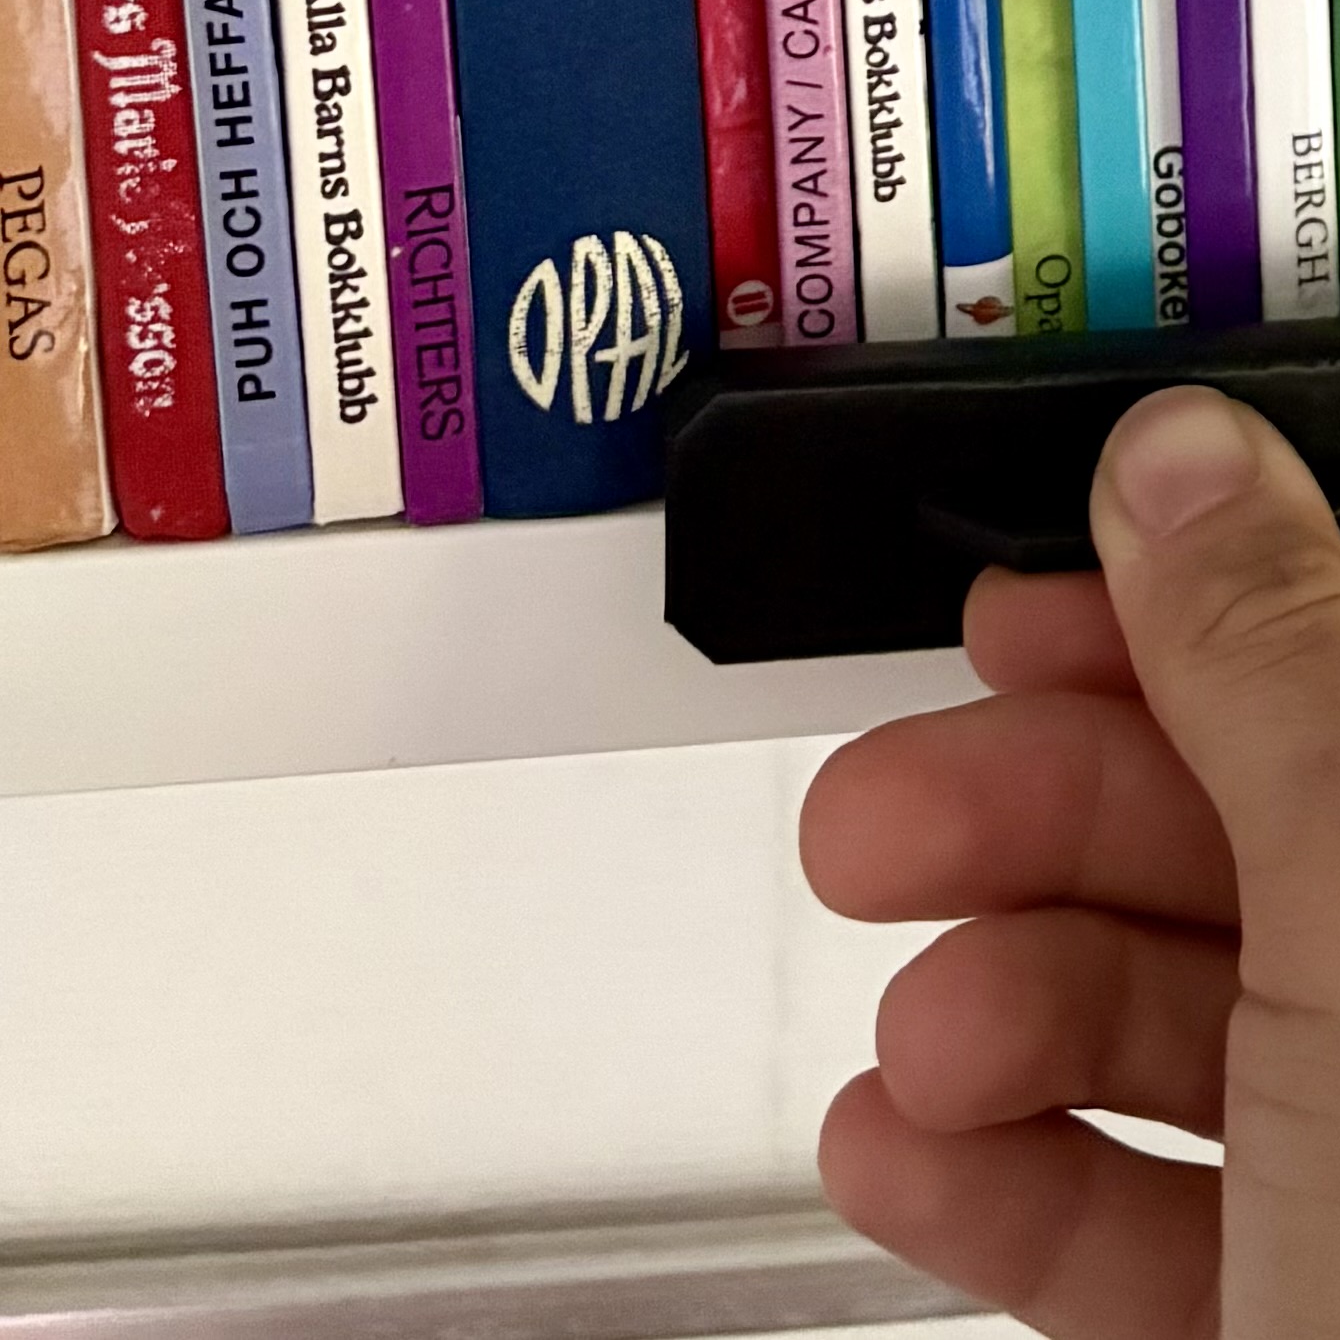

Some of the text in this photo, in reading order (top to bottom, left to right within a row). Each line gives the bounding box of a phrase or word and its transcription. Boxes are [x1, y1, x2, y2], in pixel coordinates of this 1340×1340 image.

[312, 65, 352, 200] Barns
[863, 12, 907, 204] Bokklubb
[0, 166, 55, 361] PEGAS
[219, 168, 265, 278] OCH
[324, 209, 379, 424] Bokklubb
[404, 183, 465, 440] RICHTERS
[786, 105, 835, 339] COMPANY
[231, 299, 276, 403] PUH
[508, 230, 689, 424] OPAL
